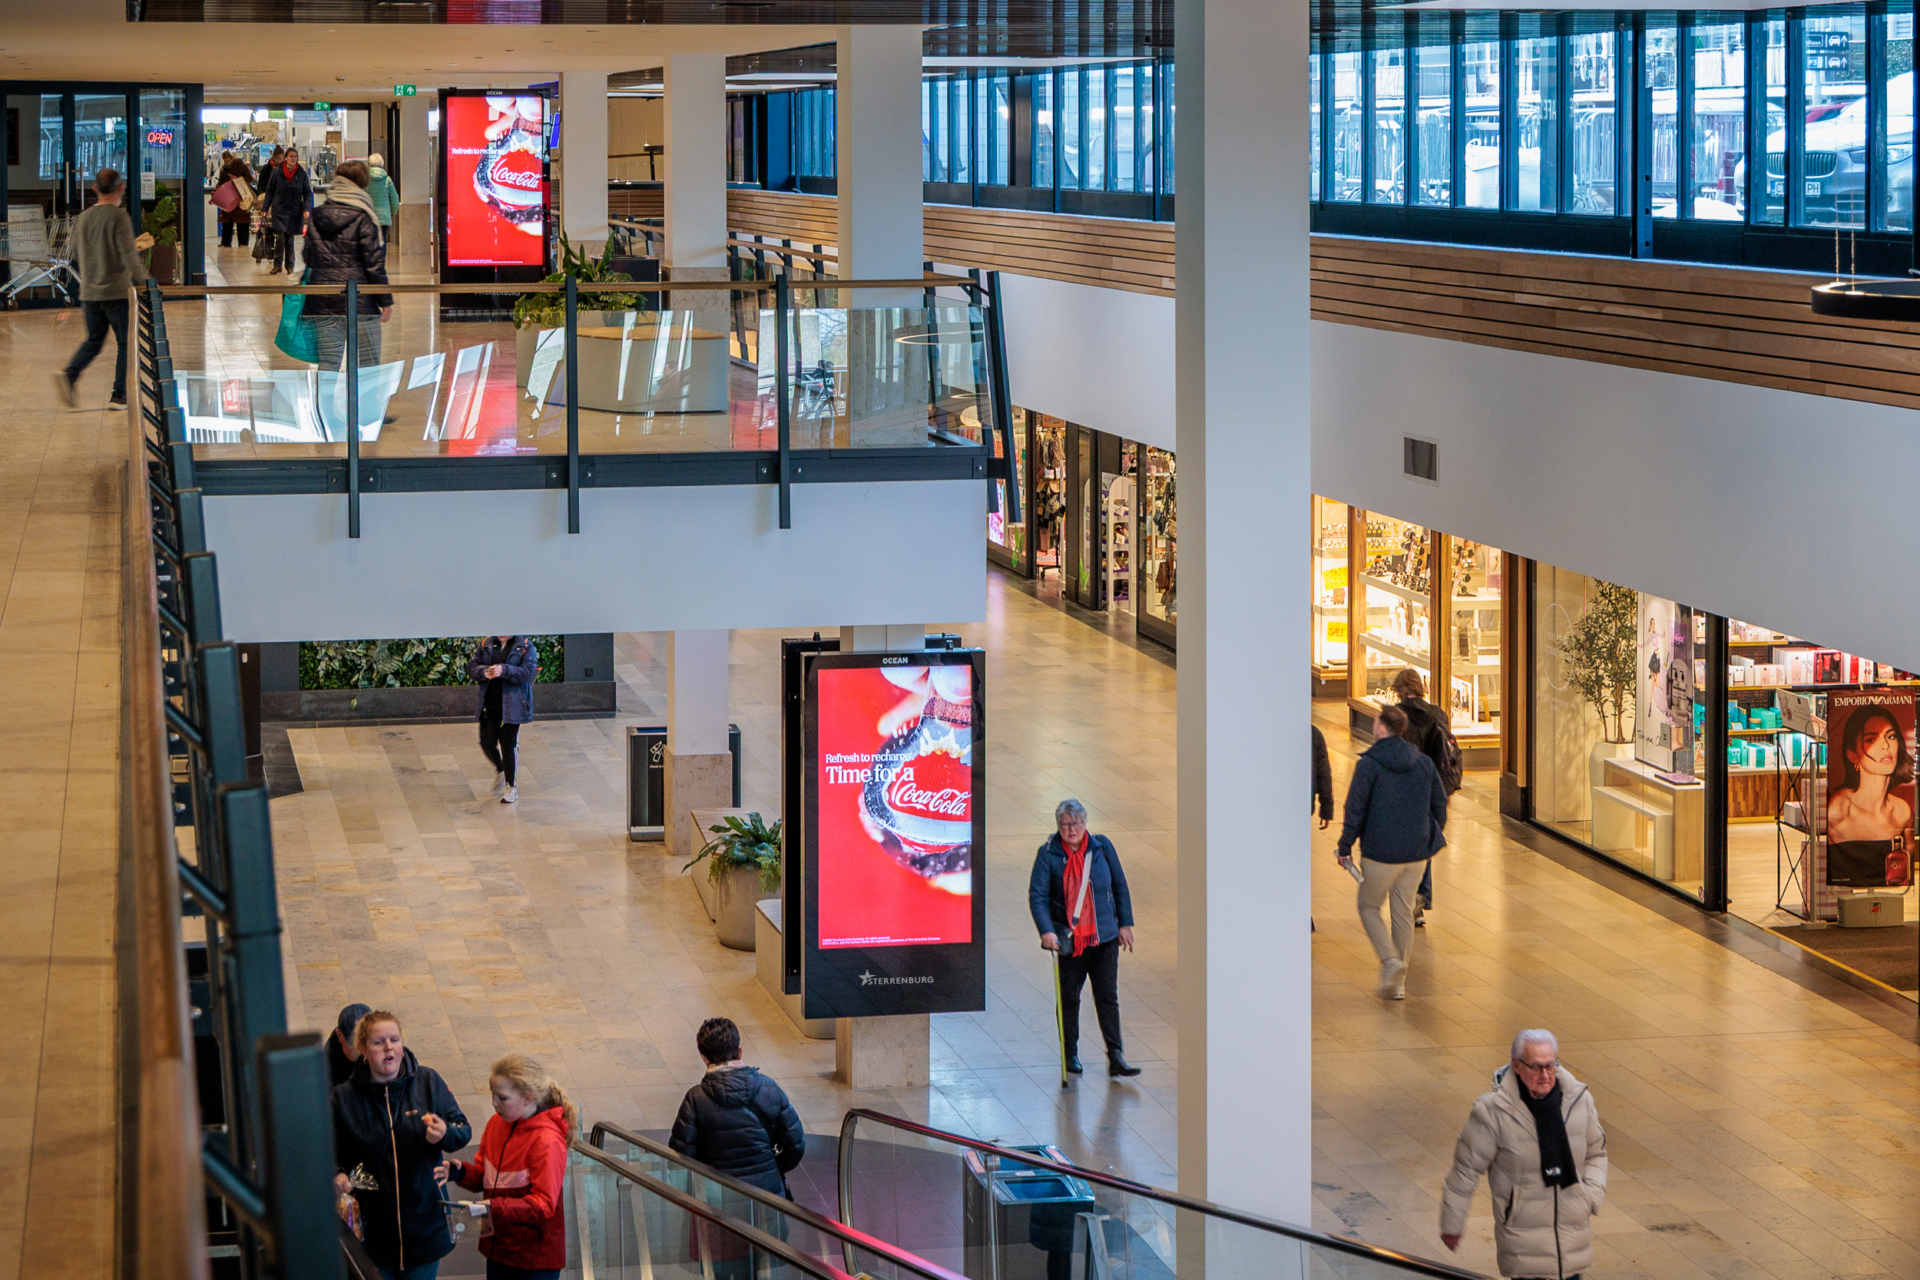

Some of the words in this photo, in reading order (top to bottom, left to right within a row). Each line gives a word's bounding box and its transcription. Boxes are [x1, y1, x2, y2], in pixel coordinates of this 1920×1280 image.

[147, 131, 173, 145] OPEN
[493, 160, 542, 189] Coca-Cola
[1328, 627, 1345, 637] SALE
[882, 656, 909, 665] OCEAN
[1834, 695, 1871, 707] EMPORIO
[1881, 695, 1913, 705] ARMANI
[825, 752, 859, 764] Refresh
[861, 752, 870, 763] to
[825, 765, 873, 784] Time
[873, 763, 901, 782] for
[903, 766, 915, 782] a
[892, 778, 972, 816] Coca-Cola
[868, 976, 934, 985] STERRENBURG
